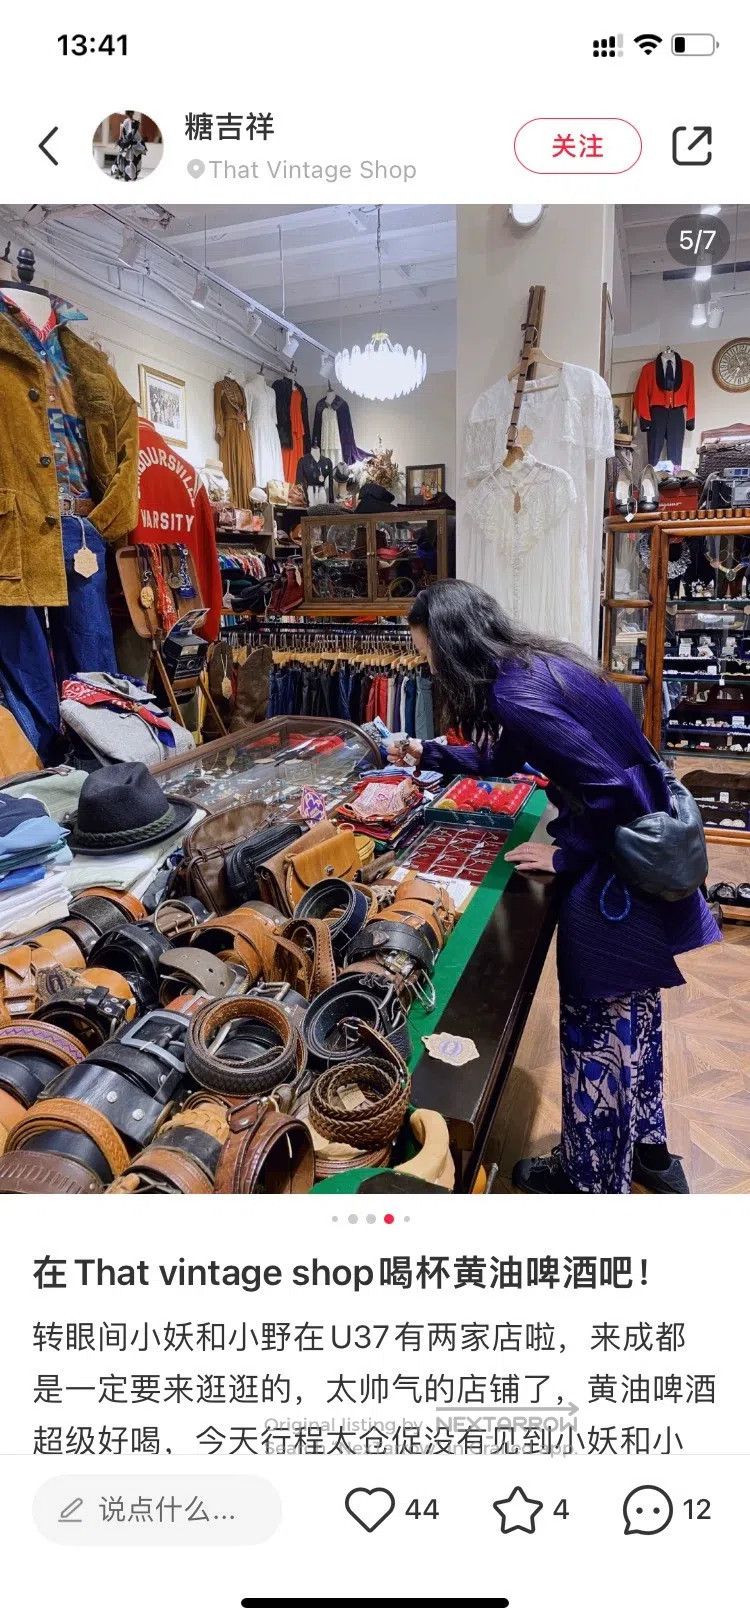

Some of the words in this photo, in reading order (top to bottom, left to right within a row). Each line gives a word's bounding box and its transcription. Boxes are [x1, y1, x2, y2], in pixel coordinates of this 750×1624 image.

[57, 33, 128, 57] 13:41
[184, 111, 275, 141] 糖吉祥
[551, 133, 604, 159] 关注
[209, 160, 259, 179] That
[267, 160, 352, 184] Vintage
[360, 160, 417, 183] Shop
[140, 508, 195, 532] VARSITY
[32, 1254, 67, 1290] 在
[74, 1257, 150, 1286] That
[159, 1256, 283, 1293] vintage
[293, 1257, 374, 1293] shop
[380, 1254, 649, 1290] 喝杯黄油啤酒吧！
[32, 1320, 324, 1353] 转眼间小妖和小野在
[331, 1324, 390, 1350] U37
[98, 1495, 236, 1524] 说点什么...
[404, 1498, 440, 1520] 44
[552, 1498, 570, 1520] 4
[683, 1498, 712, 1520] 12
